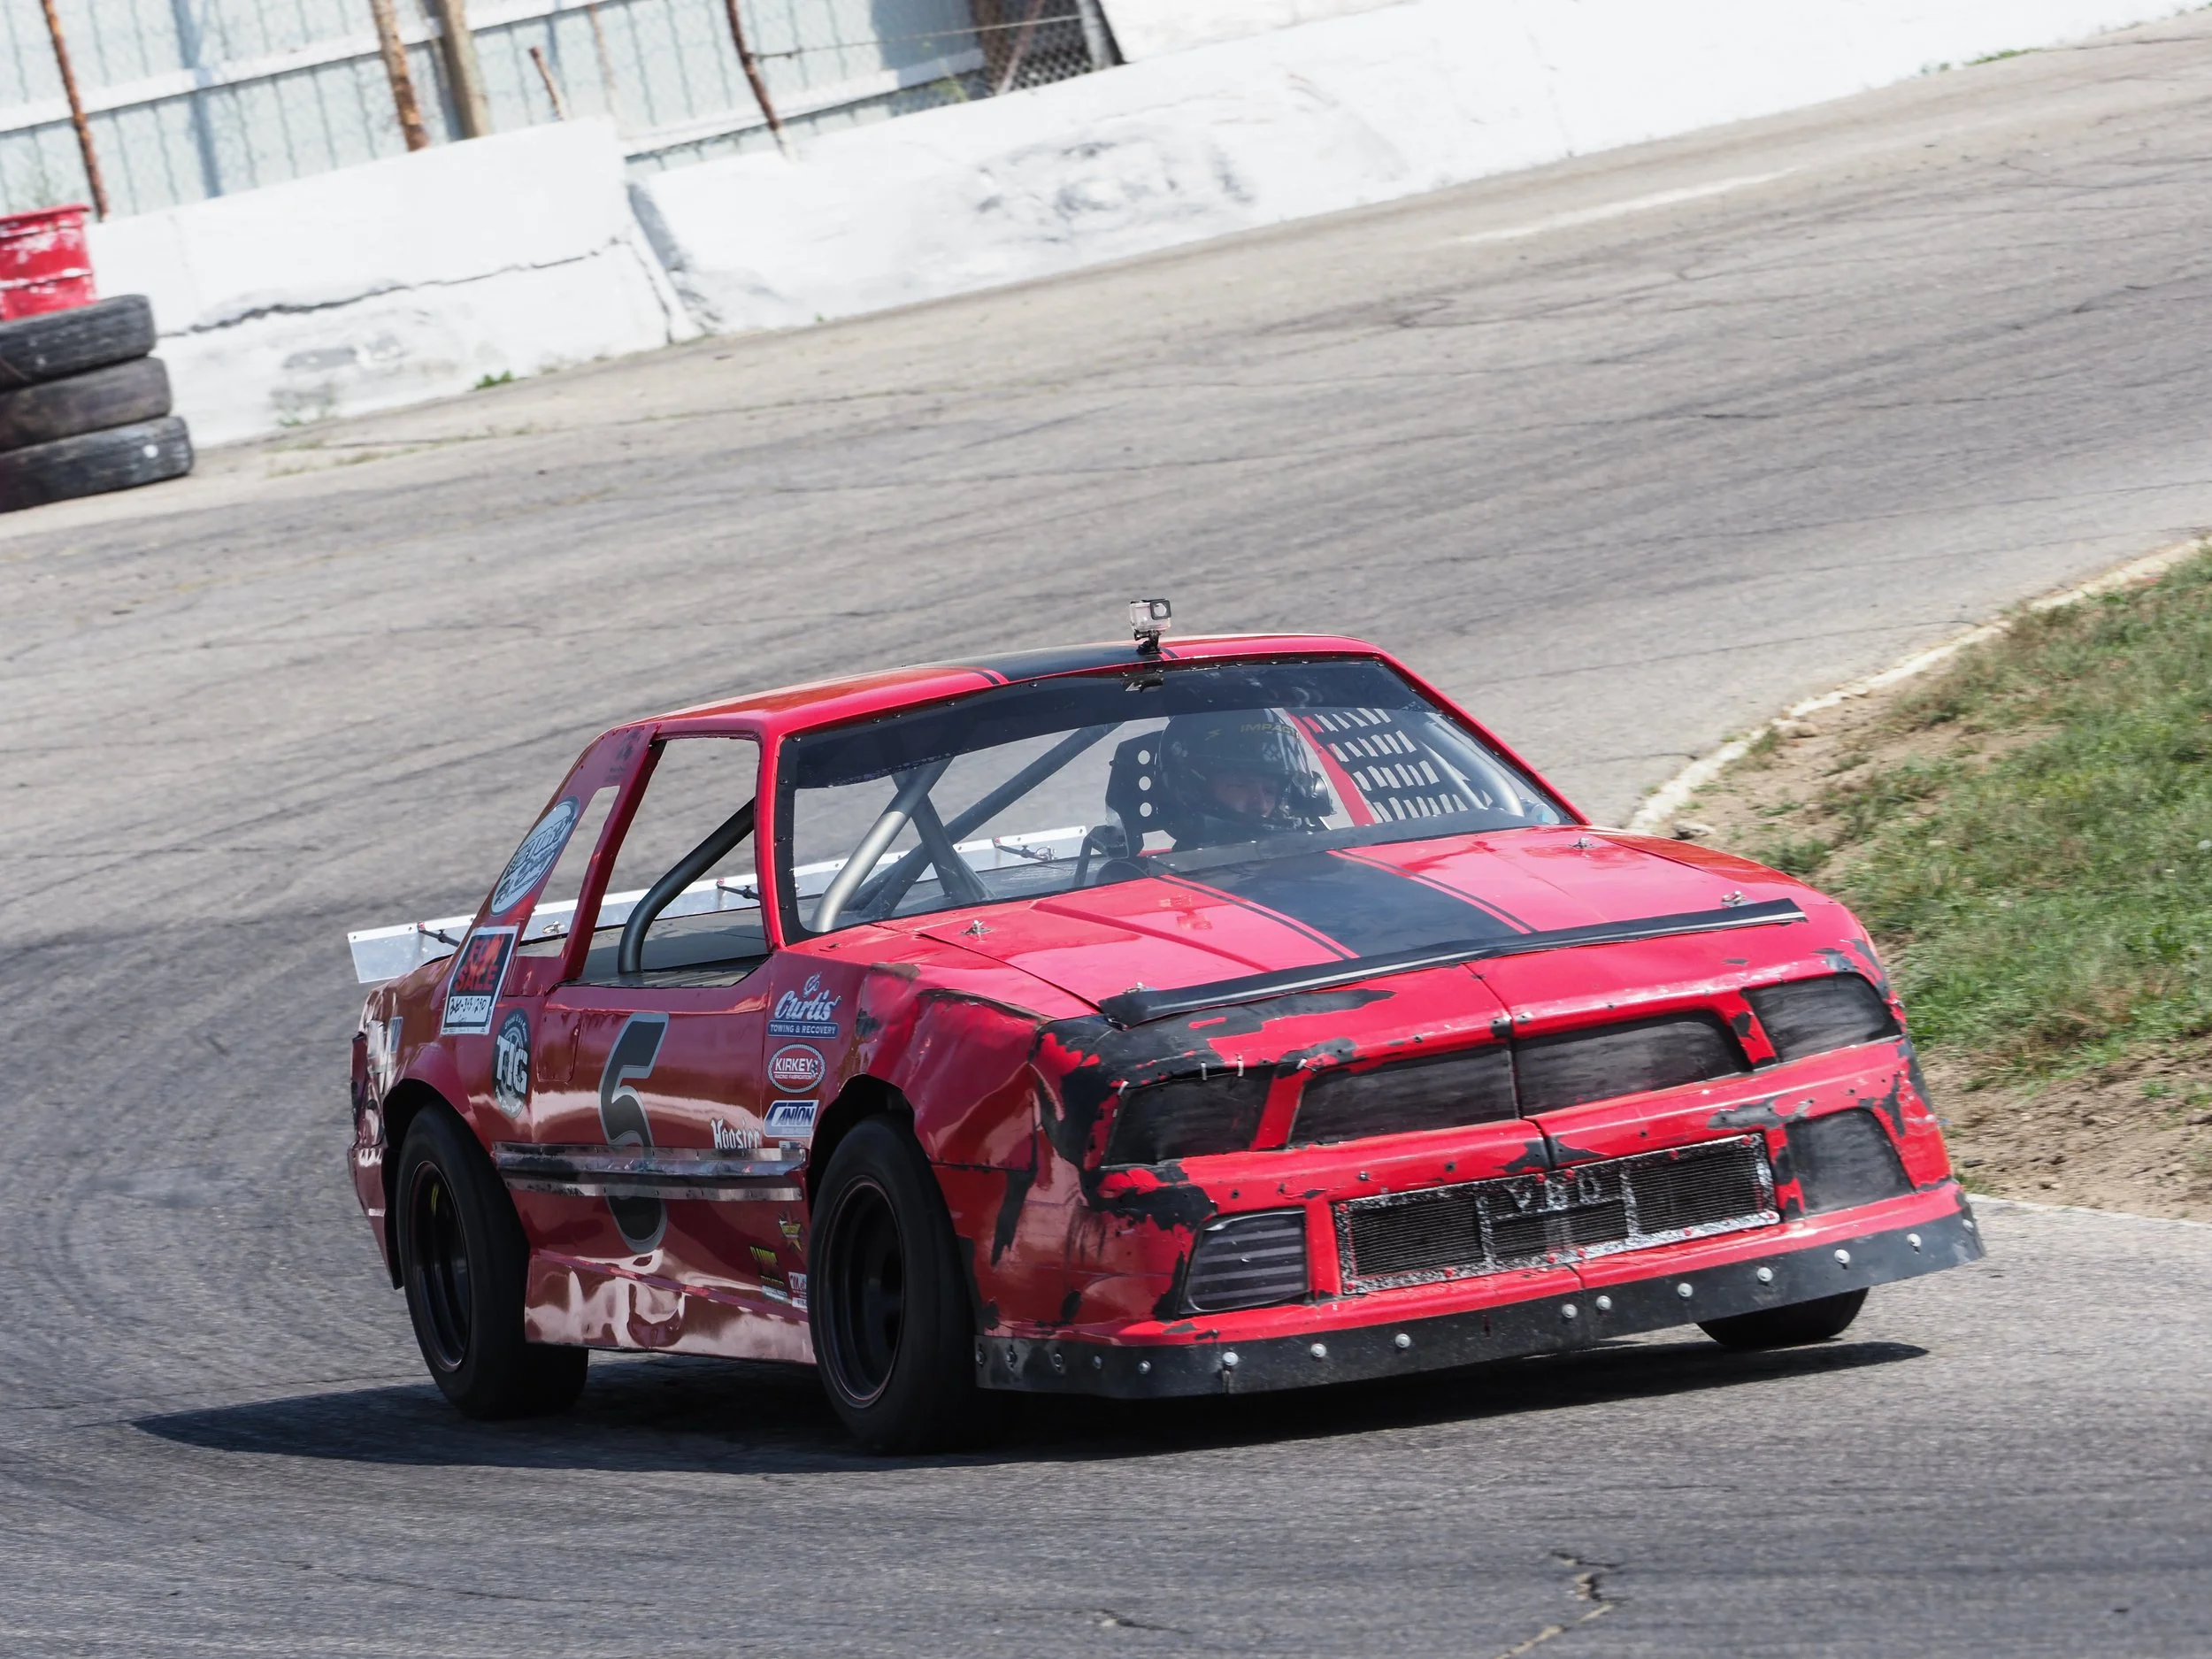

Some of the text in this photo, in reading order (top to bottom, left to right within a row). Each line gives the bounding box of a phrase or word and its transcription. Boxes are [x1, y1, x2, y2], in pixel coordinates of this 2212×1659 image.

[455, 965, 498, 991] SALE
[774, 989, 841, 1021] Curtis
[770, 1025, 836, 1034] TOWING & RECOVERY
[496, 1034, 528, 1095] TIG
[775, 1057, 813, 1072] KIRKEY
[765, 1102, 815, 1126] CANTON
[599, 1012, 669, 1254] 5
[710, 1118, 760, 1149] Hoosier
